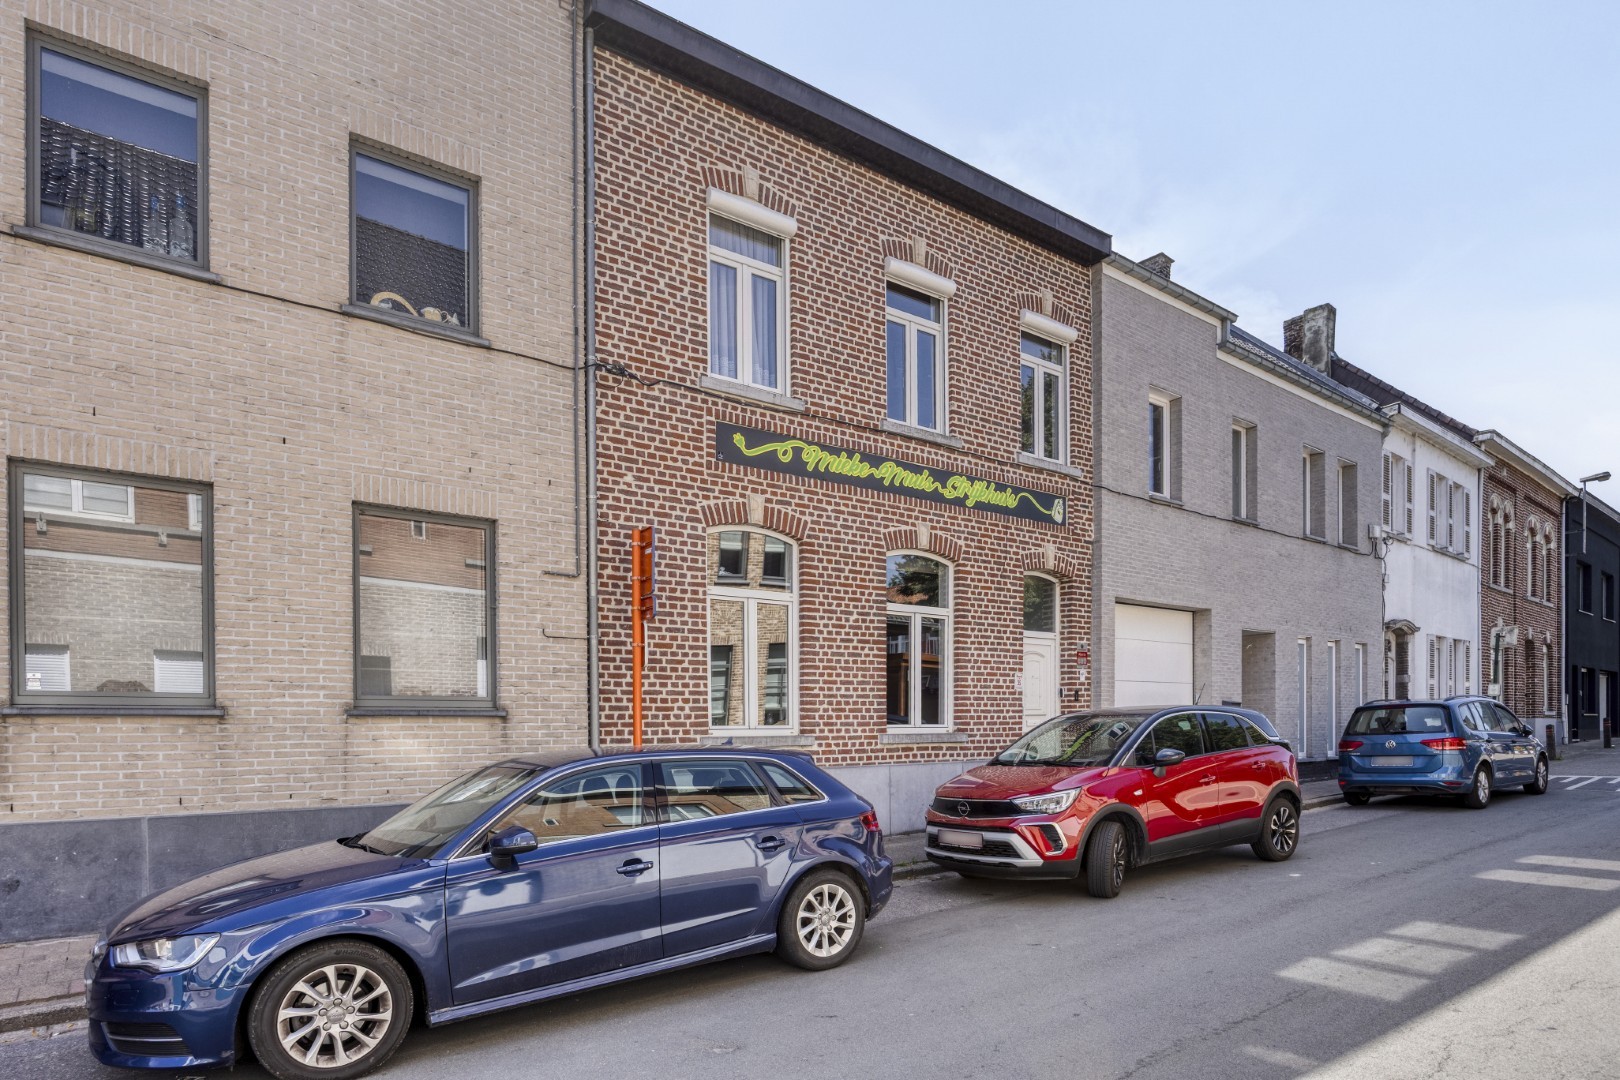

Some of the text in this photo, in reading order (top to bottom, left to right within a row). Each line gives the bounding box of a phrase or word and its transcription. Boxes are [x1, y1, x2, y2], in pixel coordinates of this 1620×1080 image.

[802, 445, 1017, 509] Mieke Muis Strijkhuis
